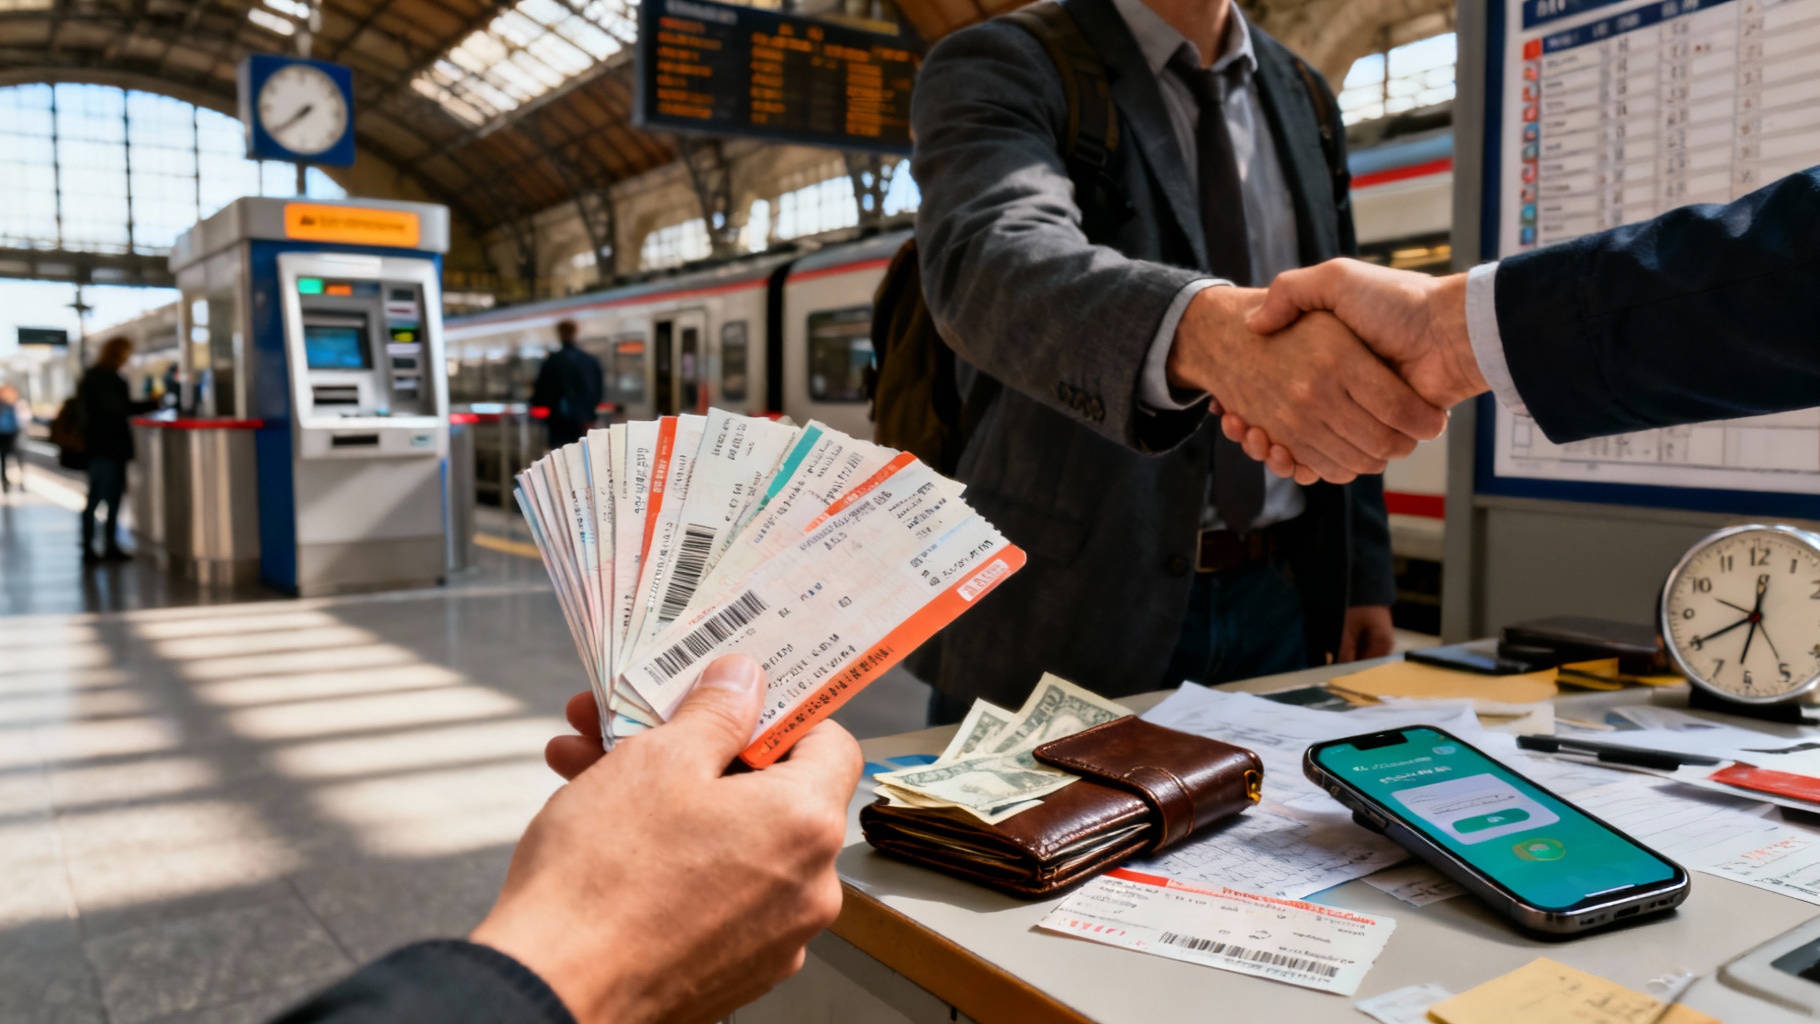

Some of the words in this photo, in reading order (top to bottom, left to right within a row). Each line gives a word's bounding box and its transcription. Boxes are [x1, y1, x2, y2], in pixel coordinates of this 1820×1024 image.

[1720, 555, 1734, 573] 11
[1750, 546, 1771, 568] 12
[1789, 558, 1798, 574] 1
[1692, 577, 1712, 593] 10
[1711, 658, 1725, 679] 7
